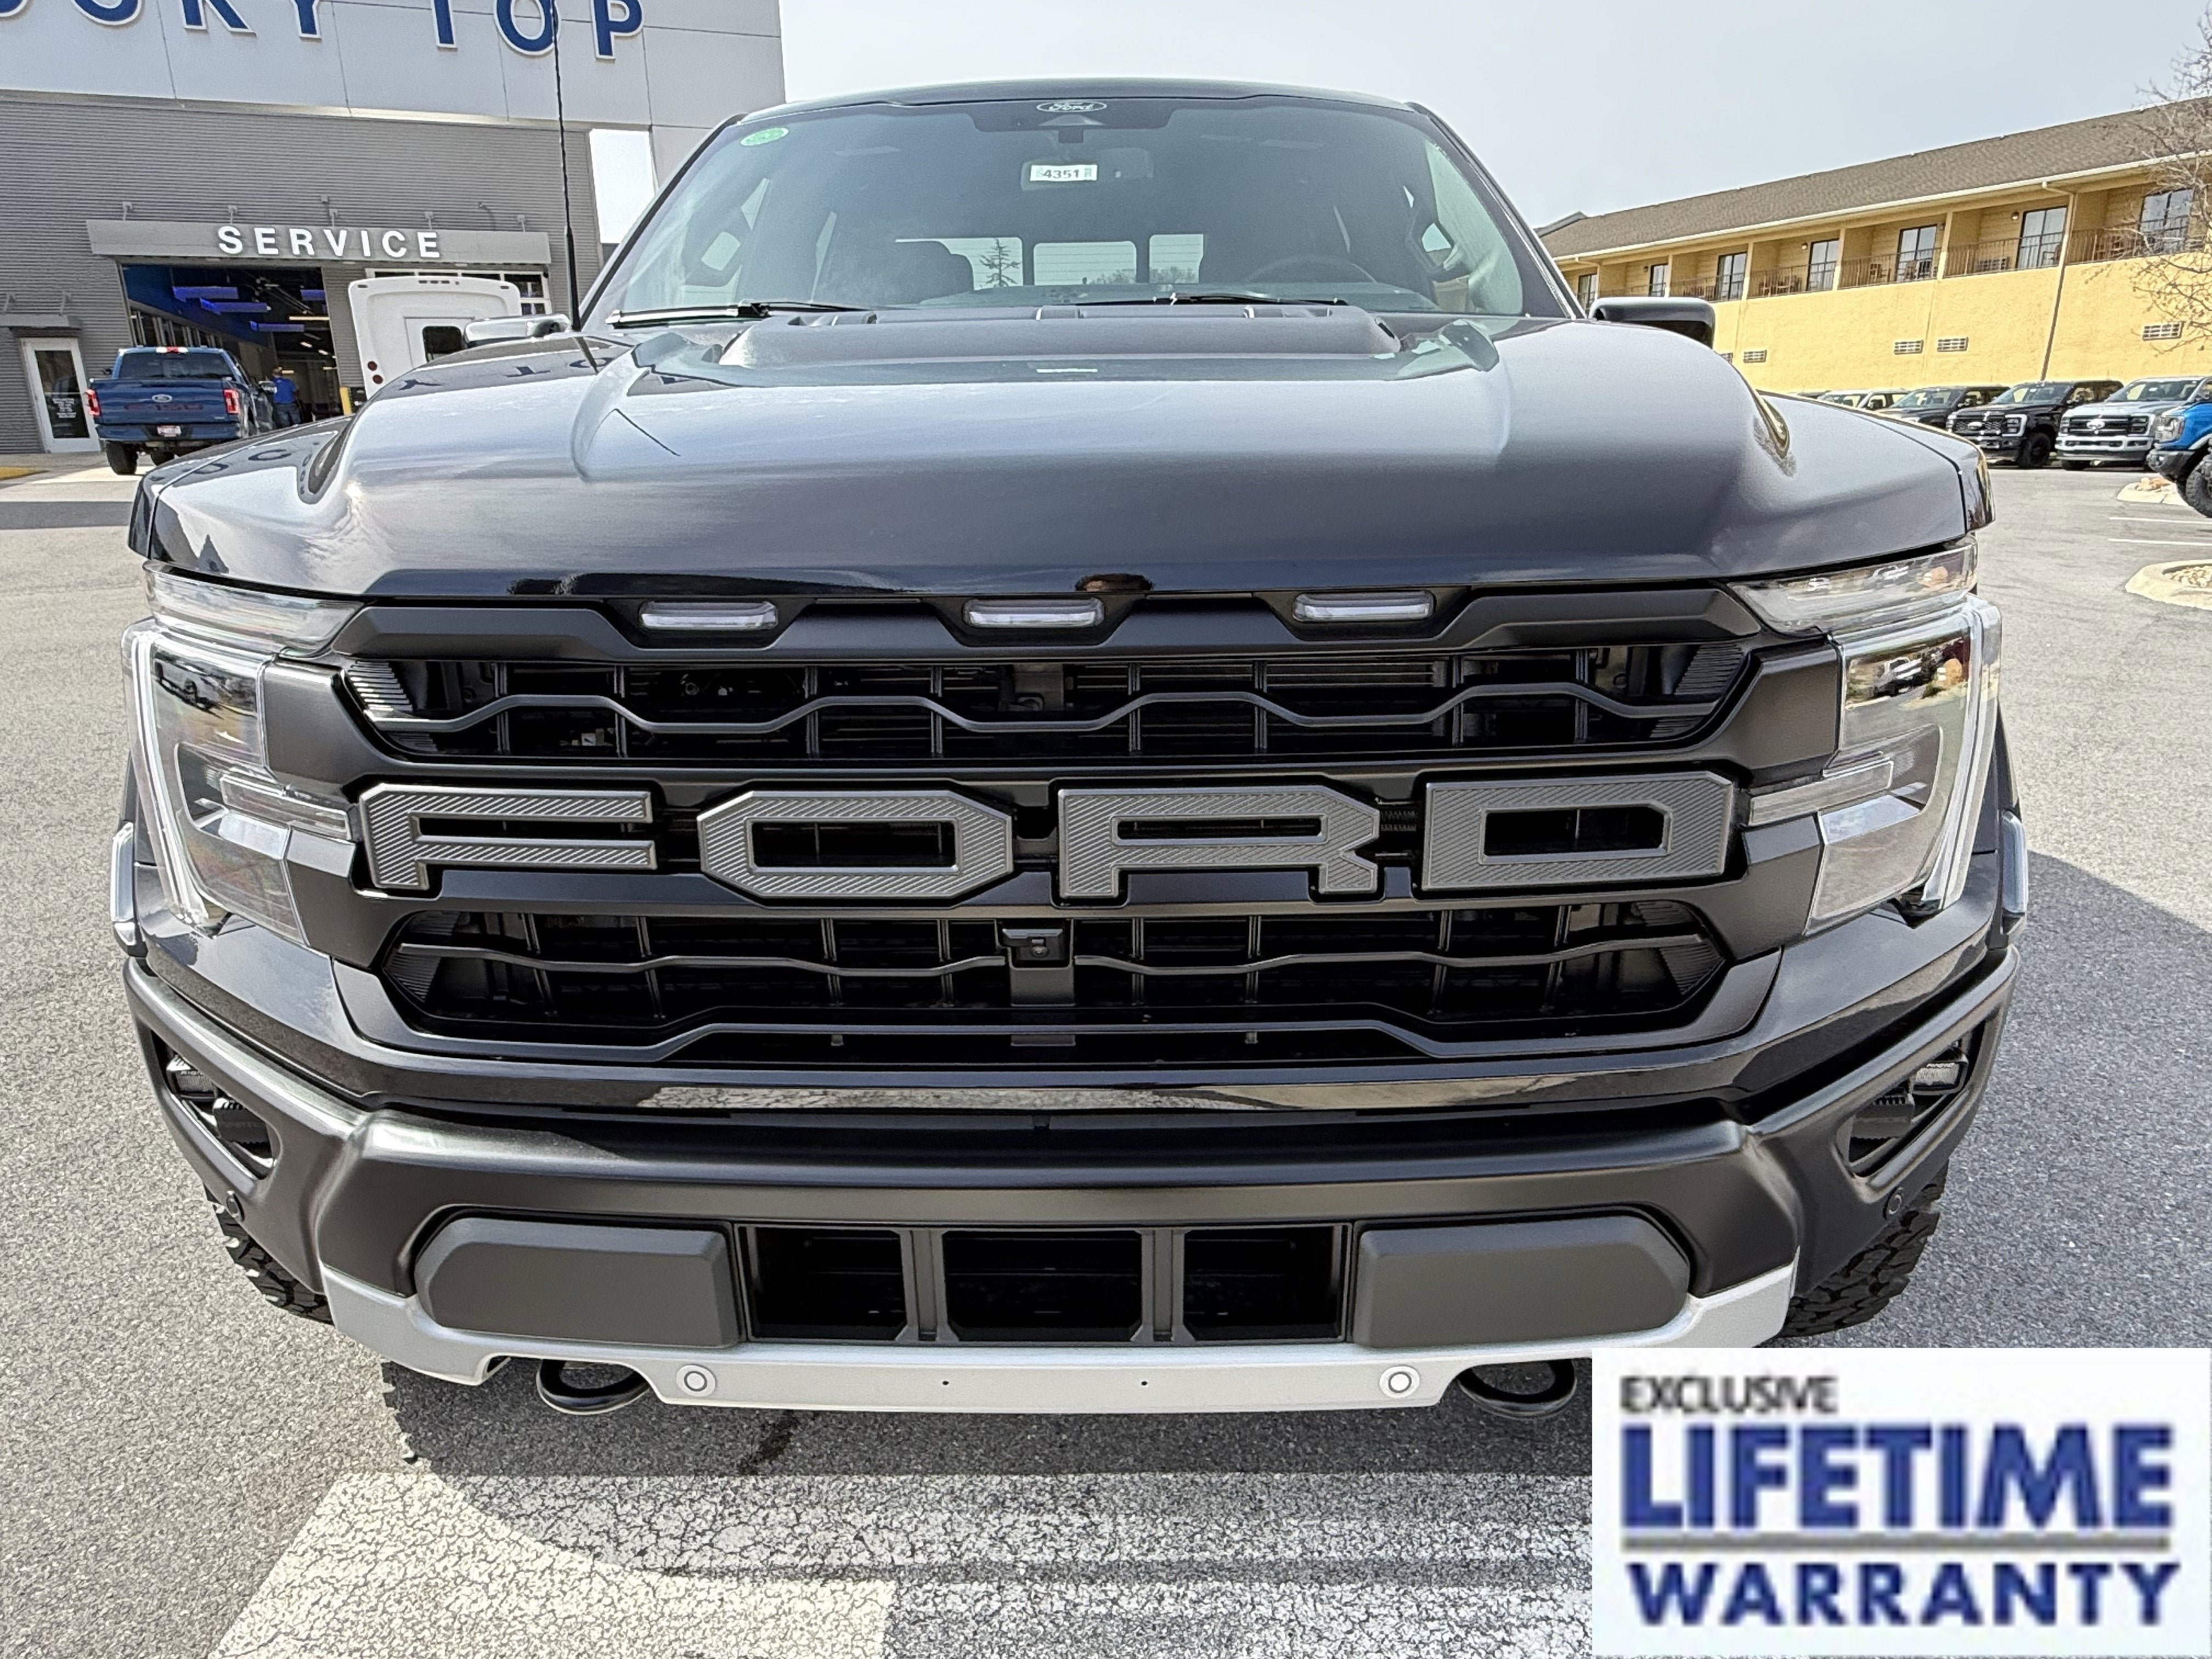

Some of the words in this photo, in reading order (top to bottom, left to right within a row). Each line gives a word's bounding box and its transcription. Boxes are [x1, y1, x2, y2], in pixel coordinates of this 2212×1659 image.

[1042, 168, 1080, 179] 4351
[218, 225, 440, 258] SERVICE
[359, 770, 1734, 898] FORD
